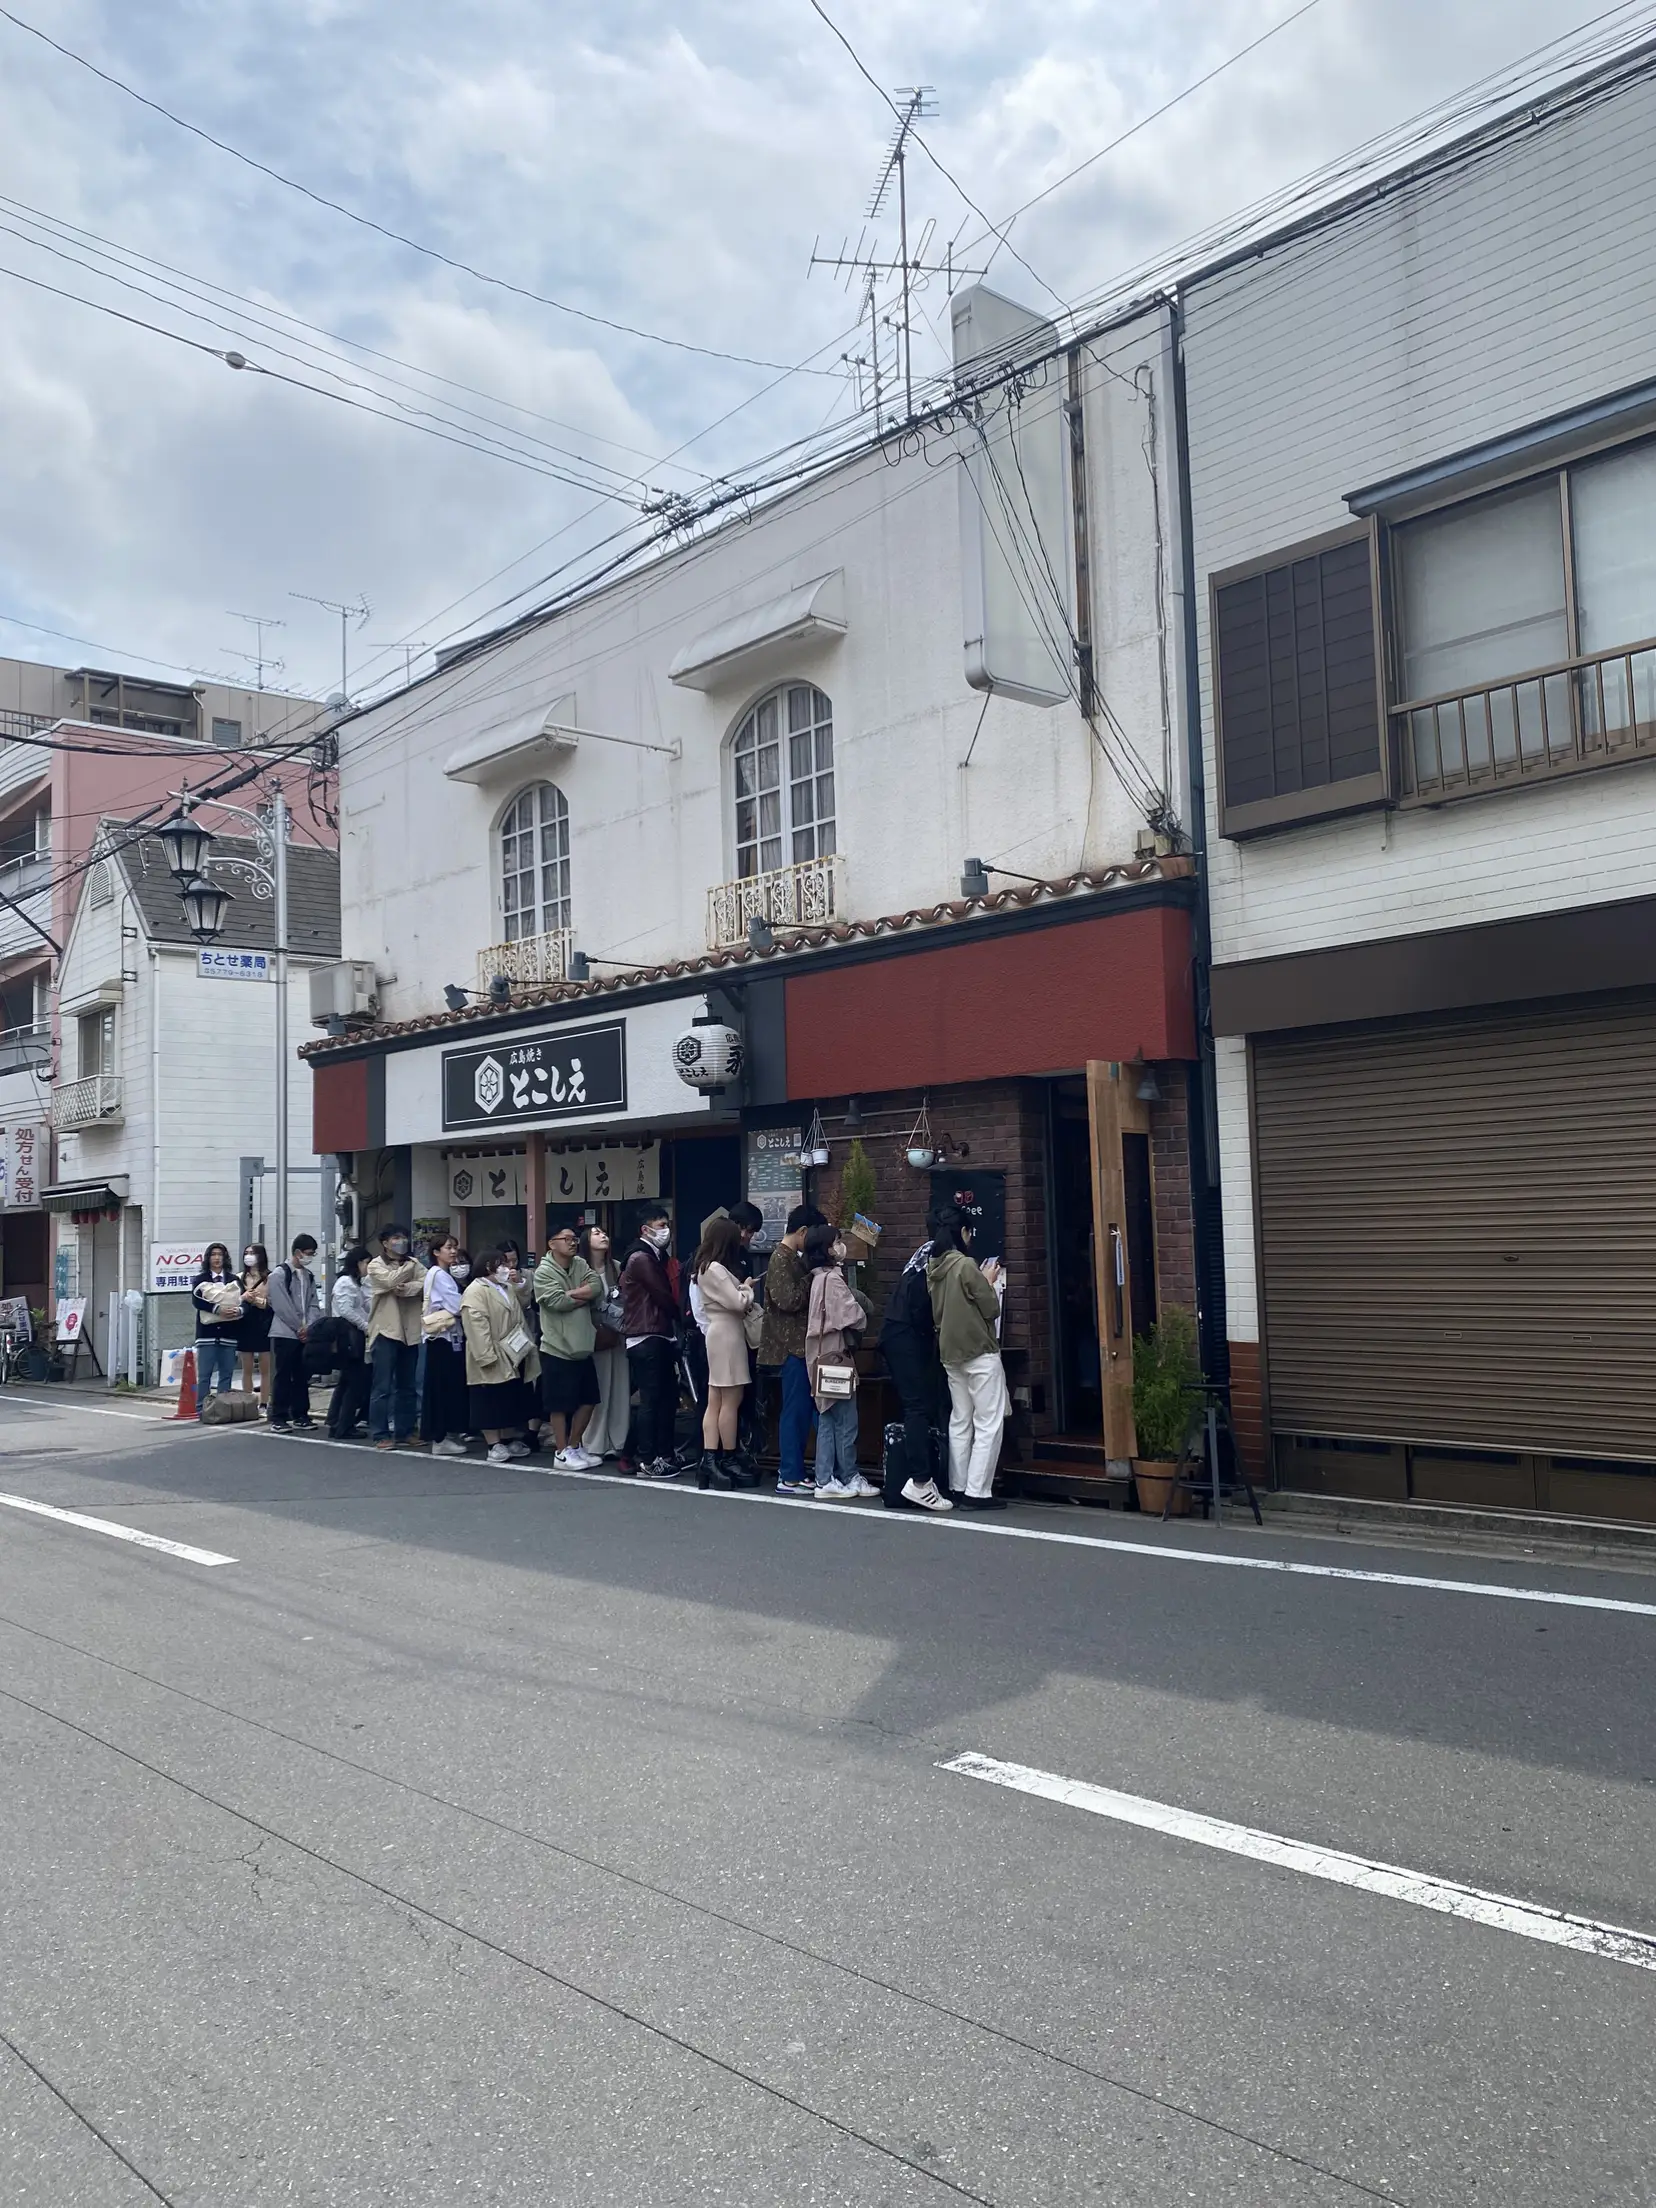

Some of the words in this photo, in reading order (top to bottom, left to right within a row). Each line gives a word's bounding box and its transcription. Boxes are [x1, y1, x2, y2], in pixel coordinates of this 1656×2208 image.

[200, 952, 266, 969] ちとせ薬局
[509, 1047, 542, 1065] 広島焼き
[509, 1058, 586, 1109] とこしえ
[768, 1136, 790, 1148] とこしえ
[15, 1128, 34, 1203] 処方せん受付
